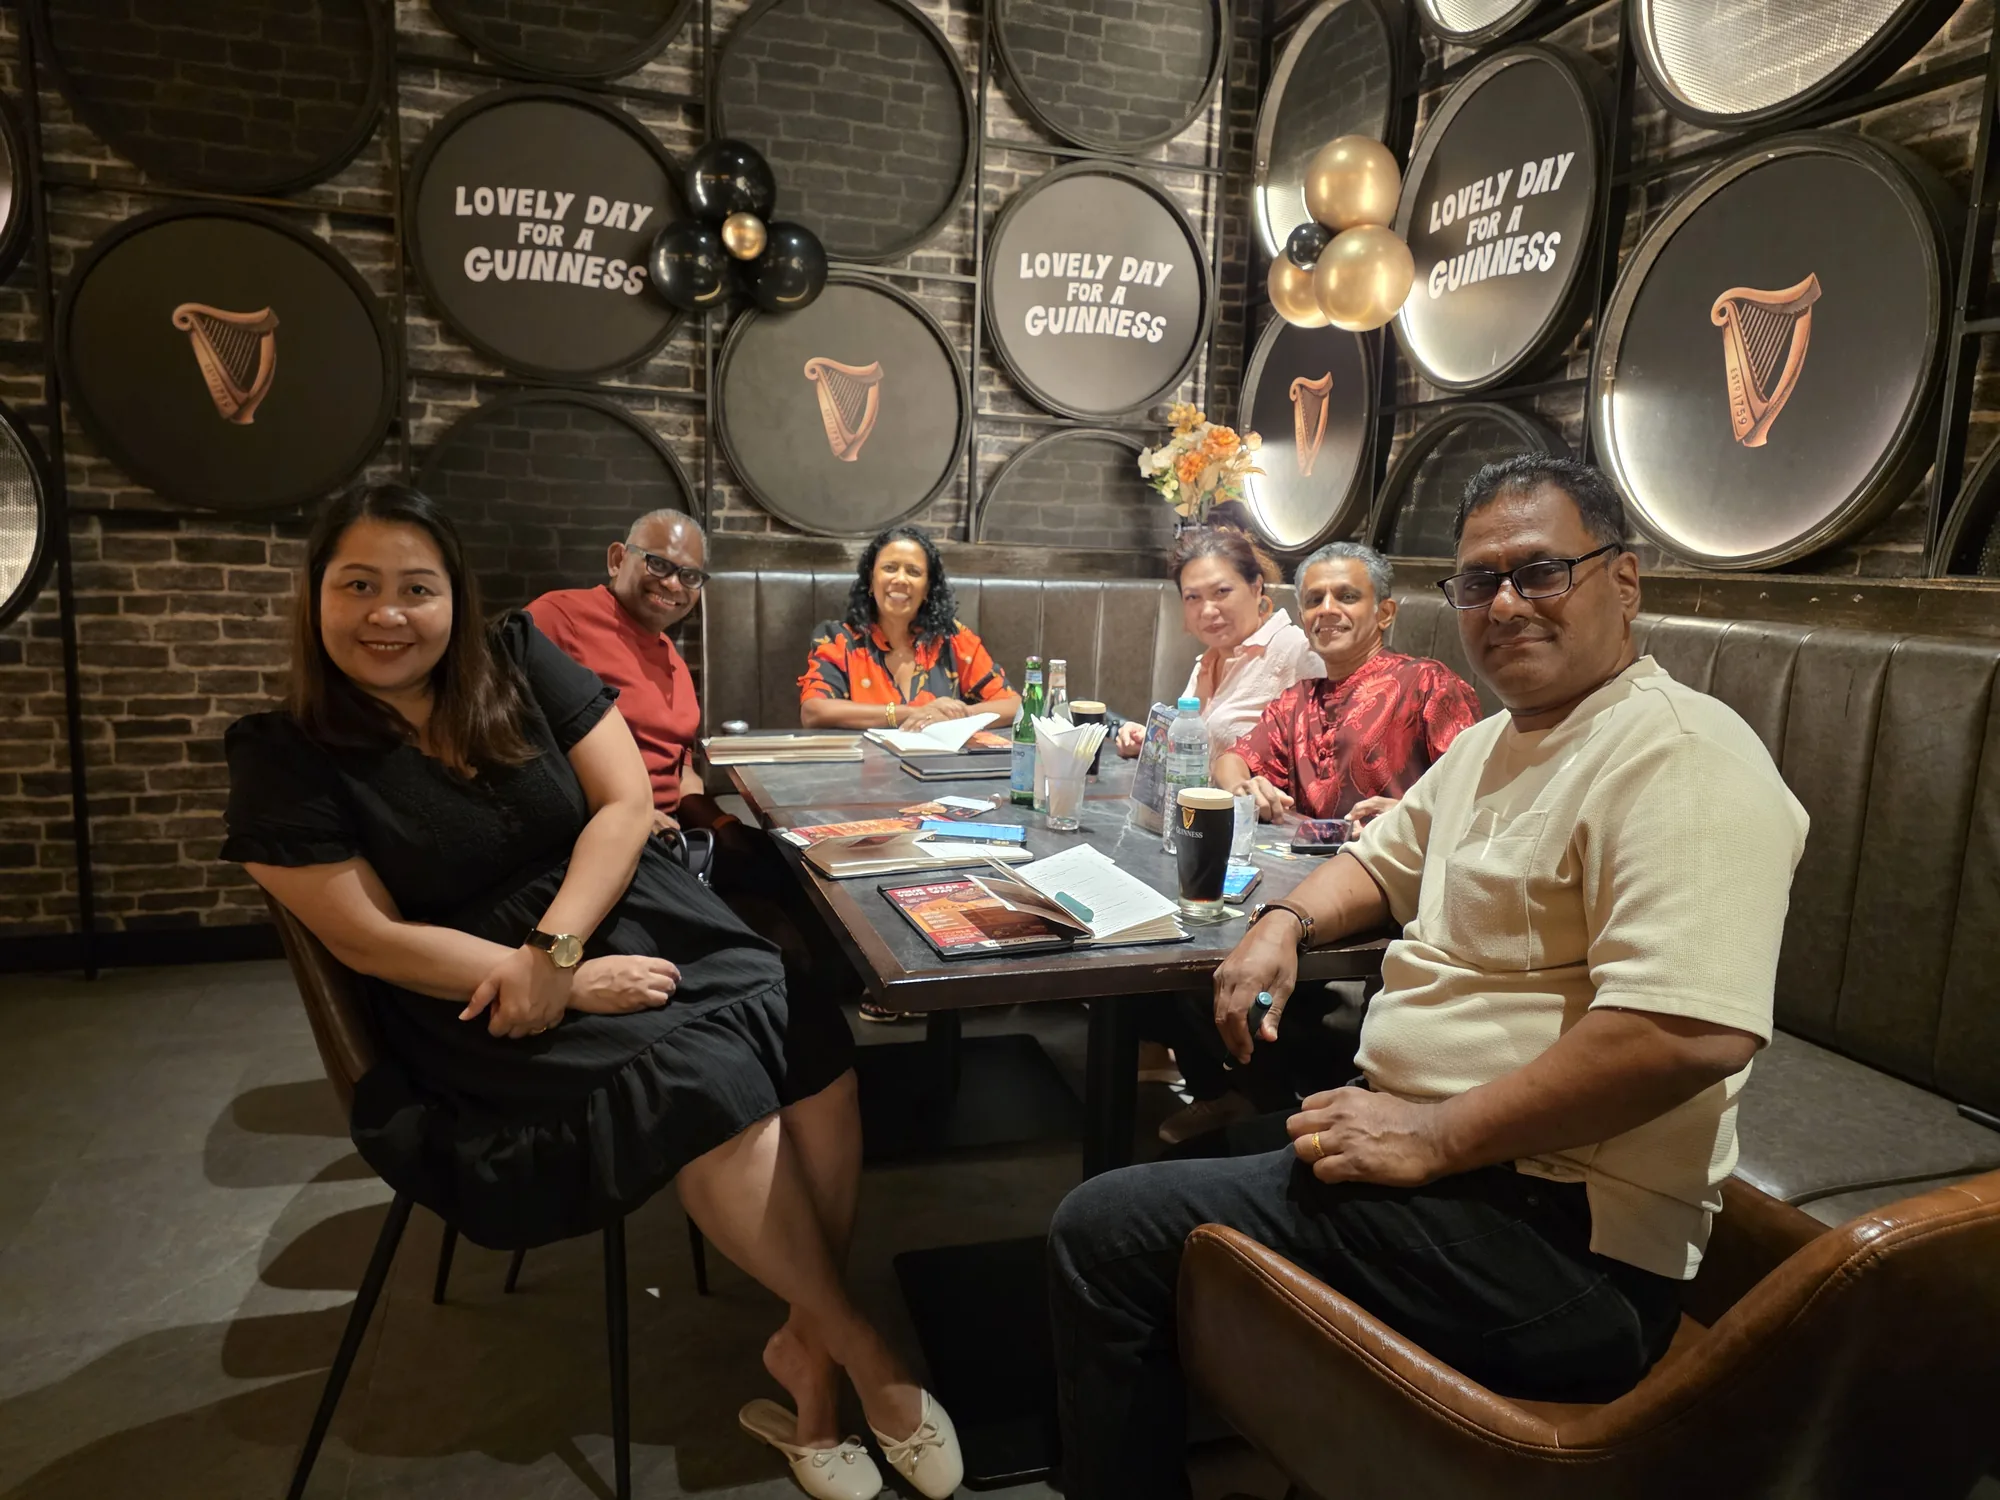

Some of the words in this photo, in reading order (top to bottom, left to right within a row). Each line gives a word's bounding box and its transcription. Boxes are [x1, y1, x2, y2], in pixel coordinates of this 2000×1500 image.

[455, 185, 575, 221] LOVELY
[584, 195, 653, 232] DAY
[1428, 168, 1514, 234] LOVELY
[1516, 152, 1575, 199] DAY
[517, 222, 564, 247] FOR
[574, 229, 595, 250] A
[1466, 211, 1501, 245] FOR
[1505, 204, 1524, 234] A
[464, 247, 648, 295] GUINNESS
[1020, 252, 1113, 280] LOVELY
[1119, 256, 1174, 287] DAY
[1428, 231, 1561, 299] GUINNESS
[1066, 282, 1104, 303] FOR
[1110, 285, 1127, 305] A
[1025, 305, 1167, 343] GUINNESS
[1733, 394, 1748, 425] 1759
